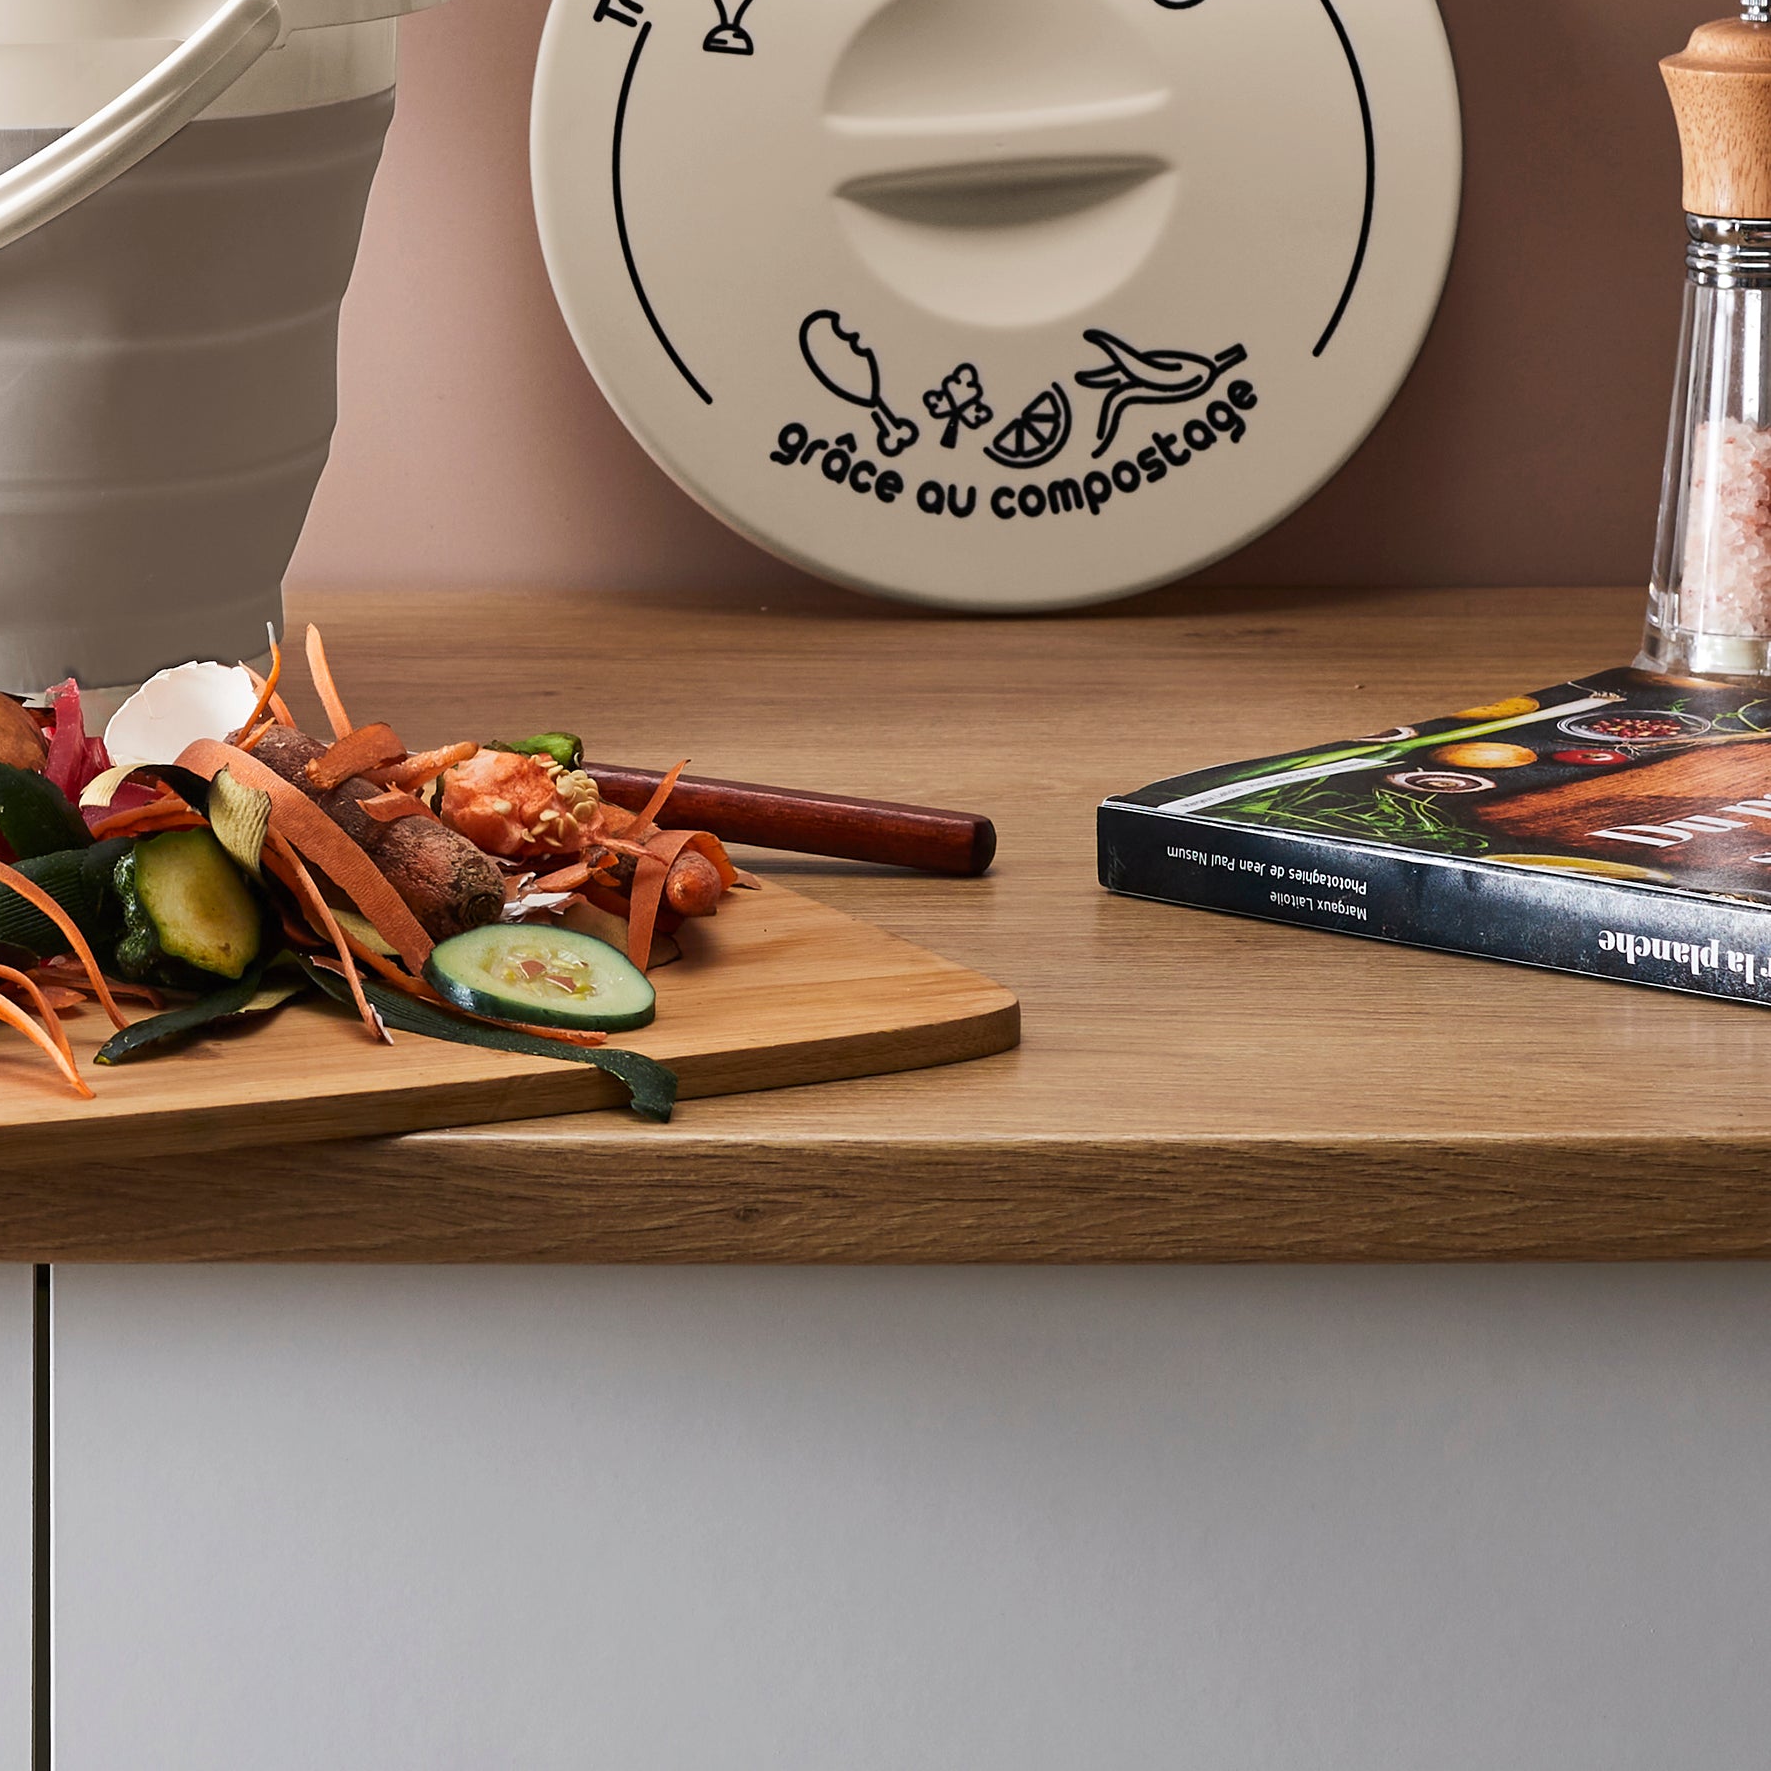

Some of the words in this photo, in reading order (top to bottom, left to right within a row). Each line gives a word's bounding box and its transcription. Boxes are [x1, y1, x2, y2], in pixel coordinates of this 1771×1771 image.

[769, 422, 905, 504] grâce
[916, 480, 977, 519] au
[990, 379, 1258, 520] compostage
[1167, 846, 1207, 866] Nasum
[1211, 855, 1235, 871] Paul
[1239, 859, 1266, 876] Jean
[1269, 865, 1285, 879] de
[1288, 870, 1367, 895] Phototaghies
[1269, 891, 1313, 911] Laitoile
[1317, 901, 1367, 921] Margaux
[1597, 930, 1721, 976] planche
[1726, 950, 1755, 985] la
